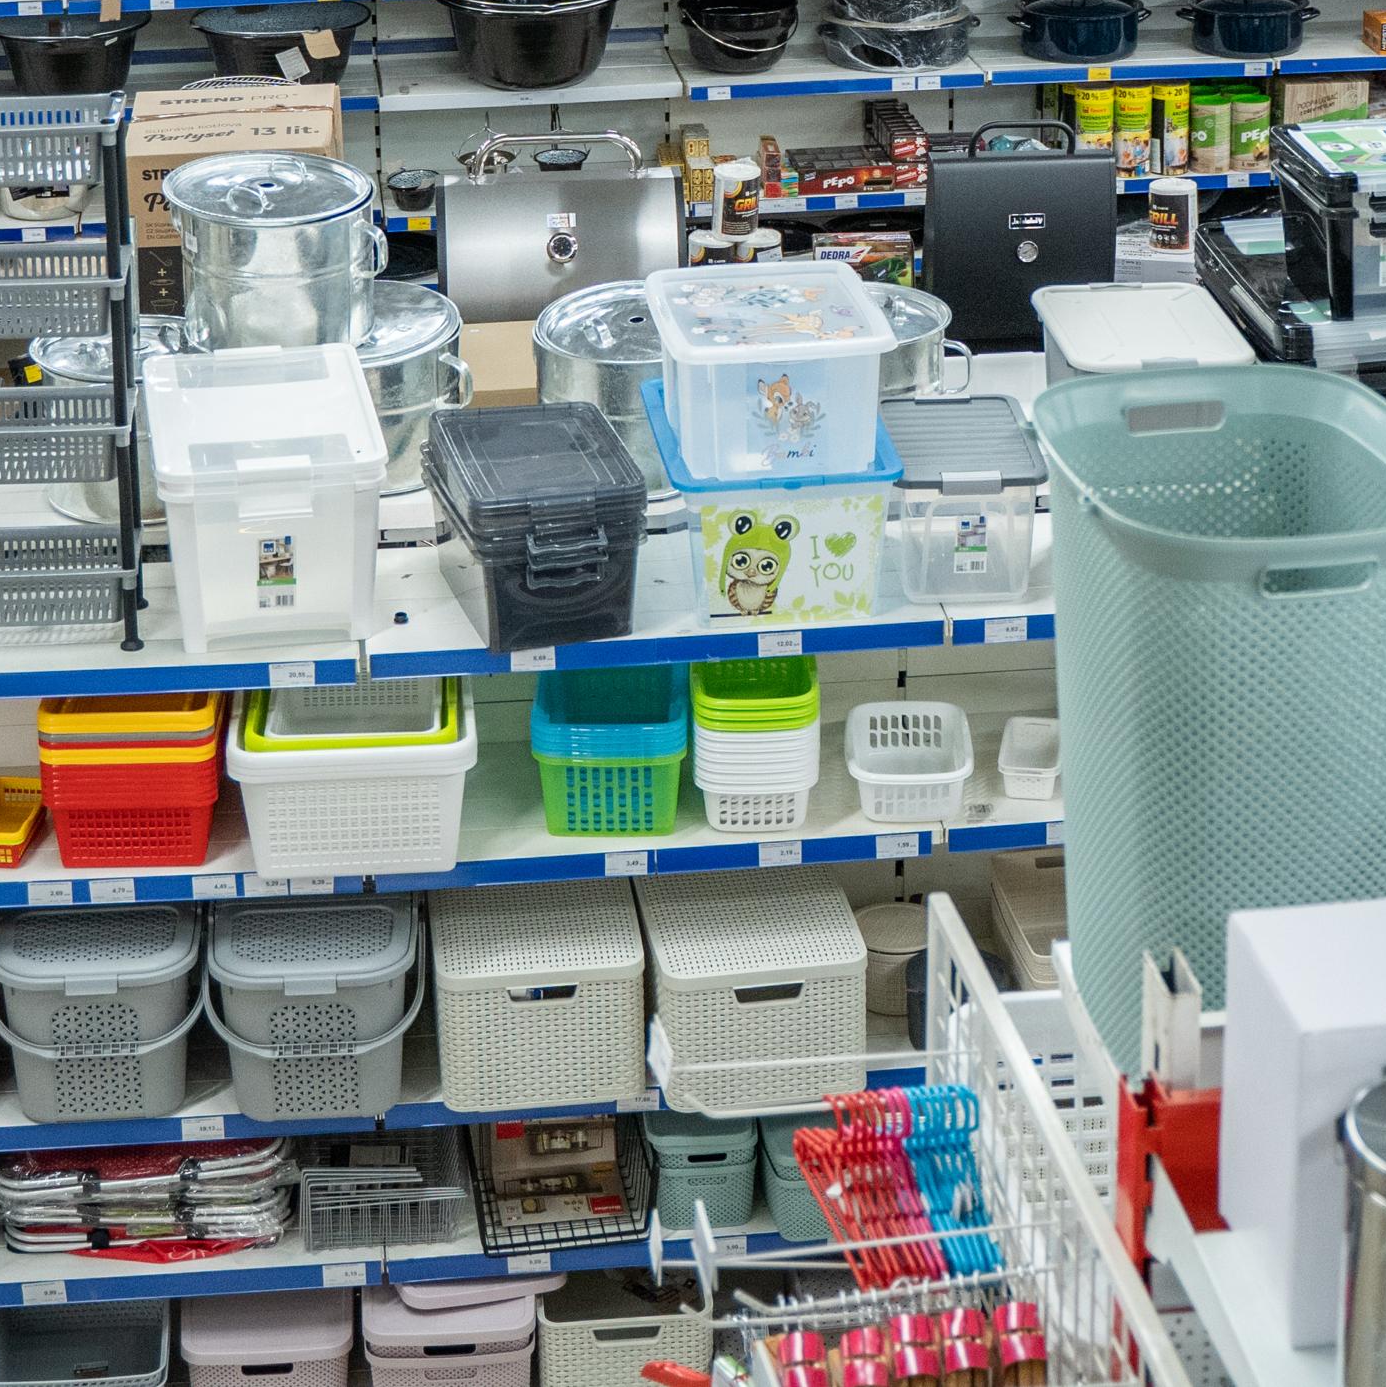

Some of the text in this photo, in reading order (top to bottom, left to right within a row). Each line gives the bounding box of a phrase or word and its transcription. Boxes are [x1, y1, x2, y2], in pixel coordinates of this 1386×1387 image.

[1081, 92, 1090, 100] 20
[1118, 90, 1127, 99] 20
[1174, 88, 1183, 96] 20
[159, 96, 244, 106] STREND
[144, 126, 319, 143] Partyset 13 lit.
[1241, 129, 1270, 142] PEP
[823, 175, 855, 189] PEPO
[820, 250, 851, 260] DEDRA
[809, 535, 820, 559] I
[809, 563, 854, 588] YOU
